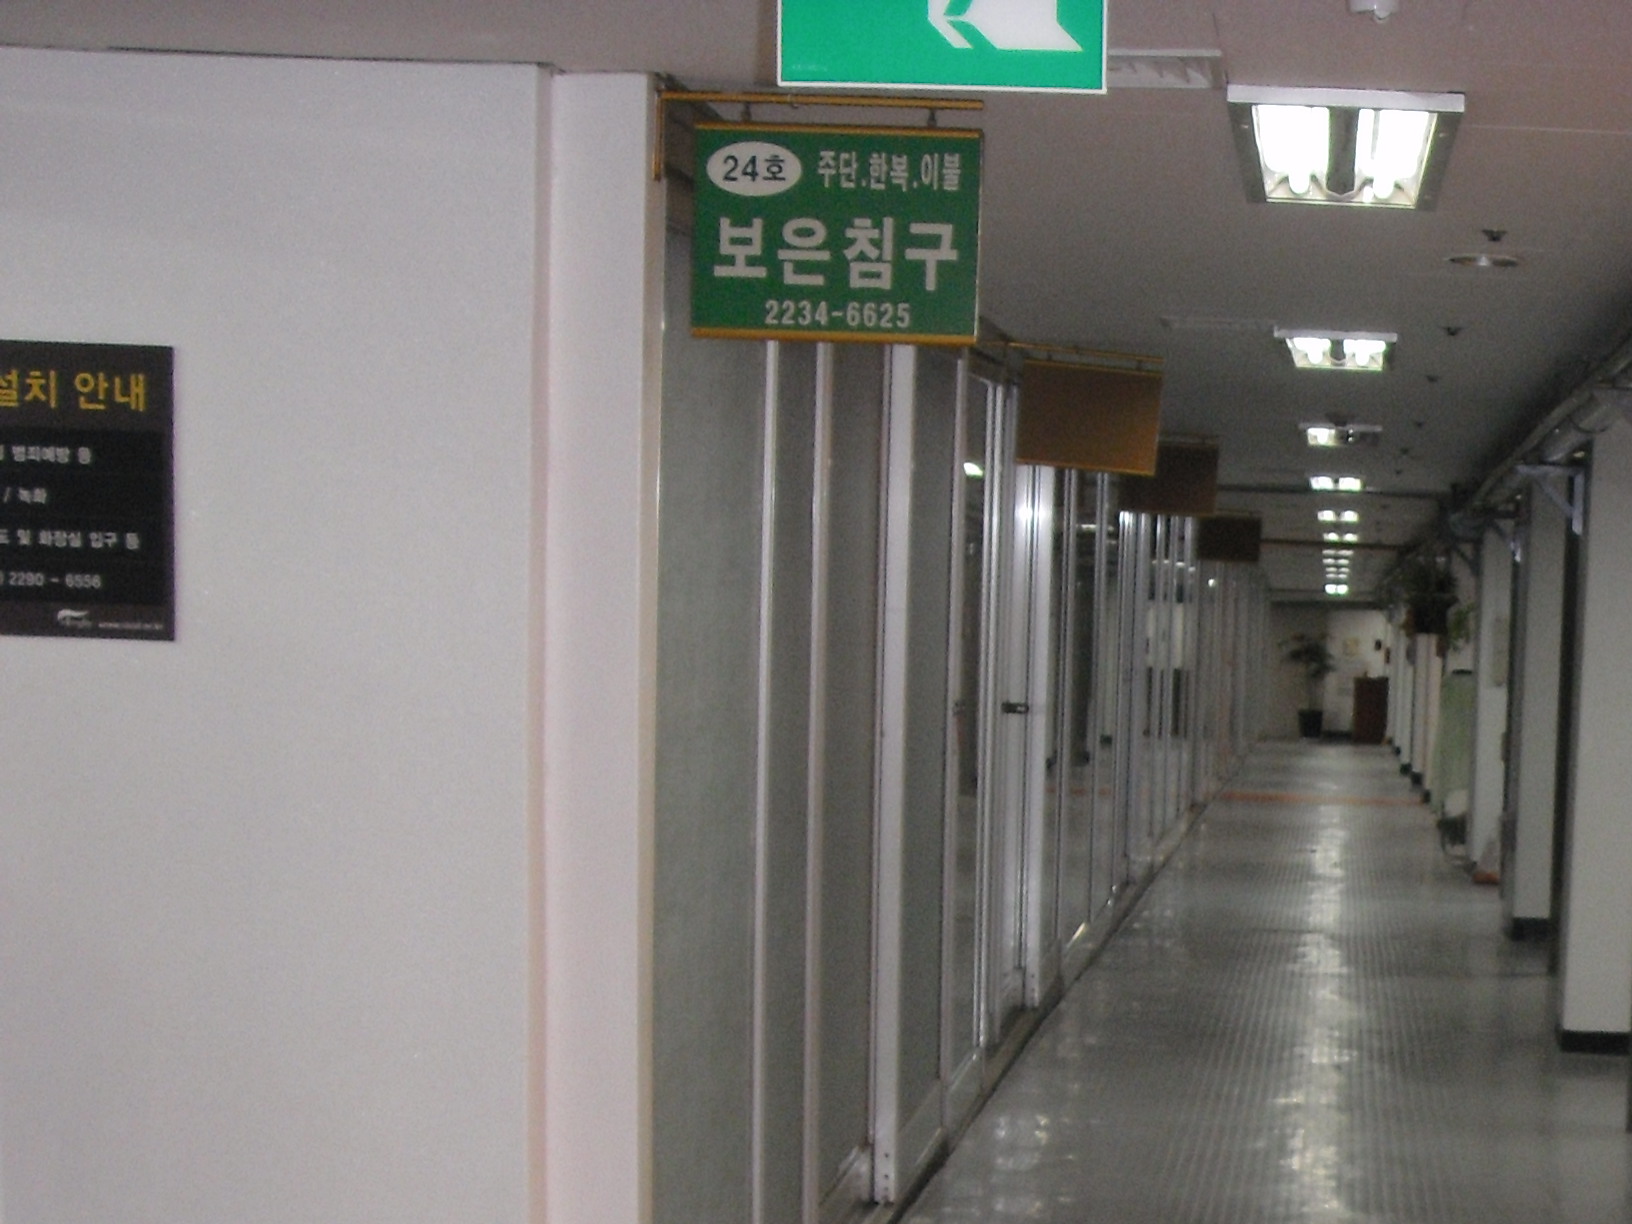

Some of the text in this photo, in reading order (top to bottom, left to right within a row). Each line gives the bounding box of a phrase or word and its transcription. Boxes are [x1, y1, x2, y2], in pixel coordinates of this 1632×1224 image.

[722, 154, 787, 182] 24호
[713, 216, 959, 292] 보은침구
[764, 300, 911, 329] 2234-6625
[74, 372, 147, 413] 안내
[89, 531, 118, 549] 입구
